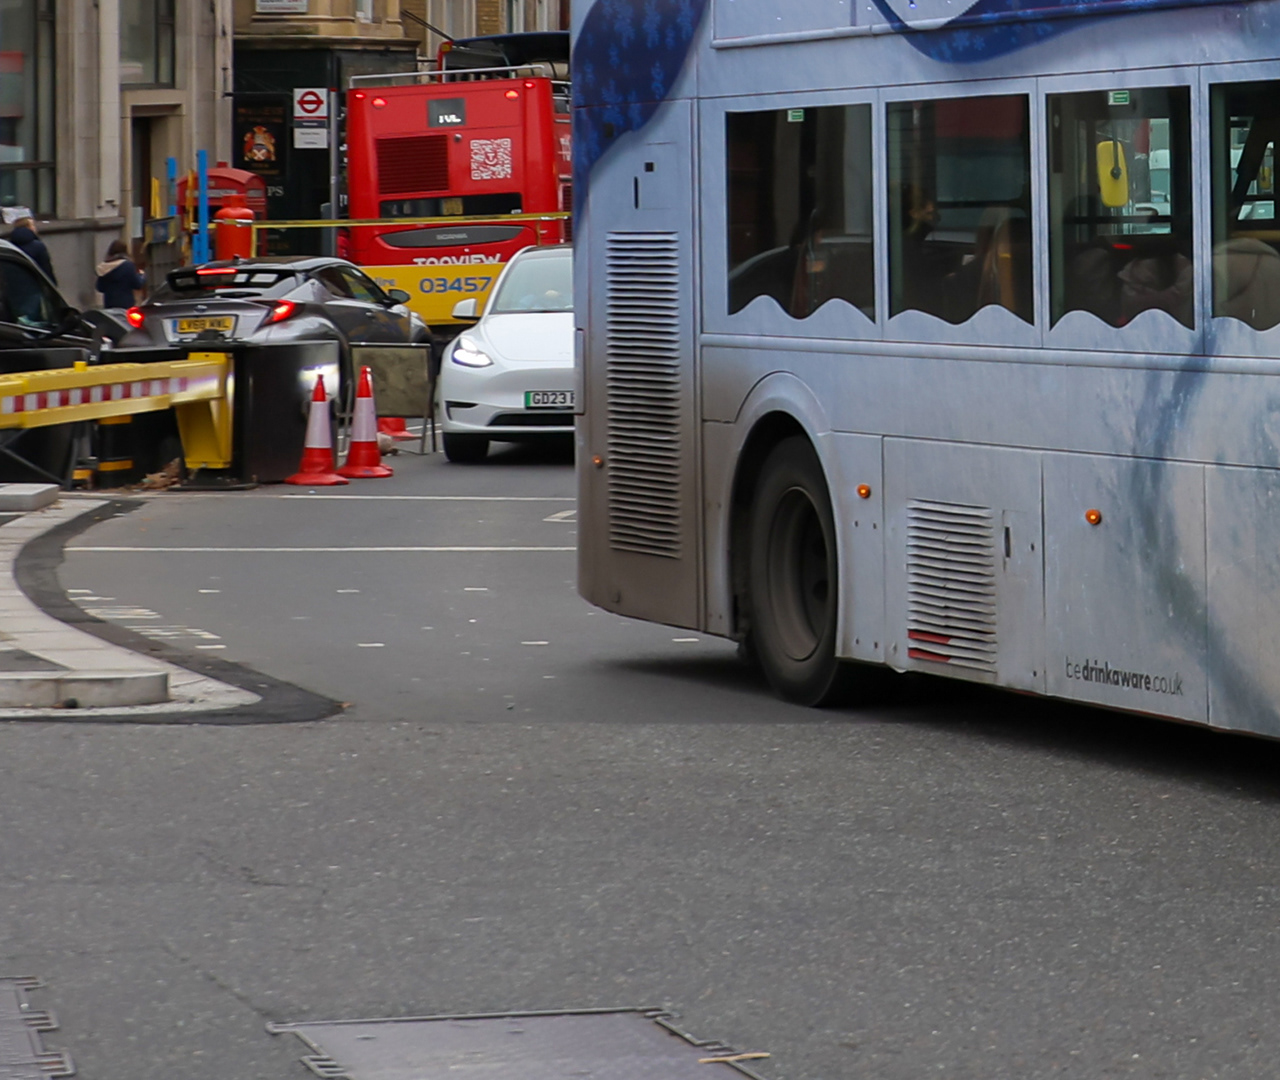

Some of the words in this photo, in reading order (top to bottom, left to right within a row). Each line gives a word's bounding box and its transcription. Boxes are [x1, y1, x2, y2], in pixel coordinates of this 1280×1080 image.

[419, 277, 492, 294] 03457
[532, 392, 567, 404] GD23
[1065, 656, 1183, 696] bedrinkaware.co.uk
